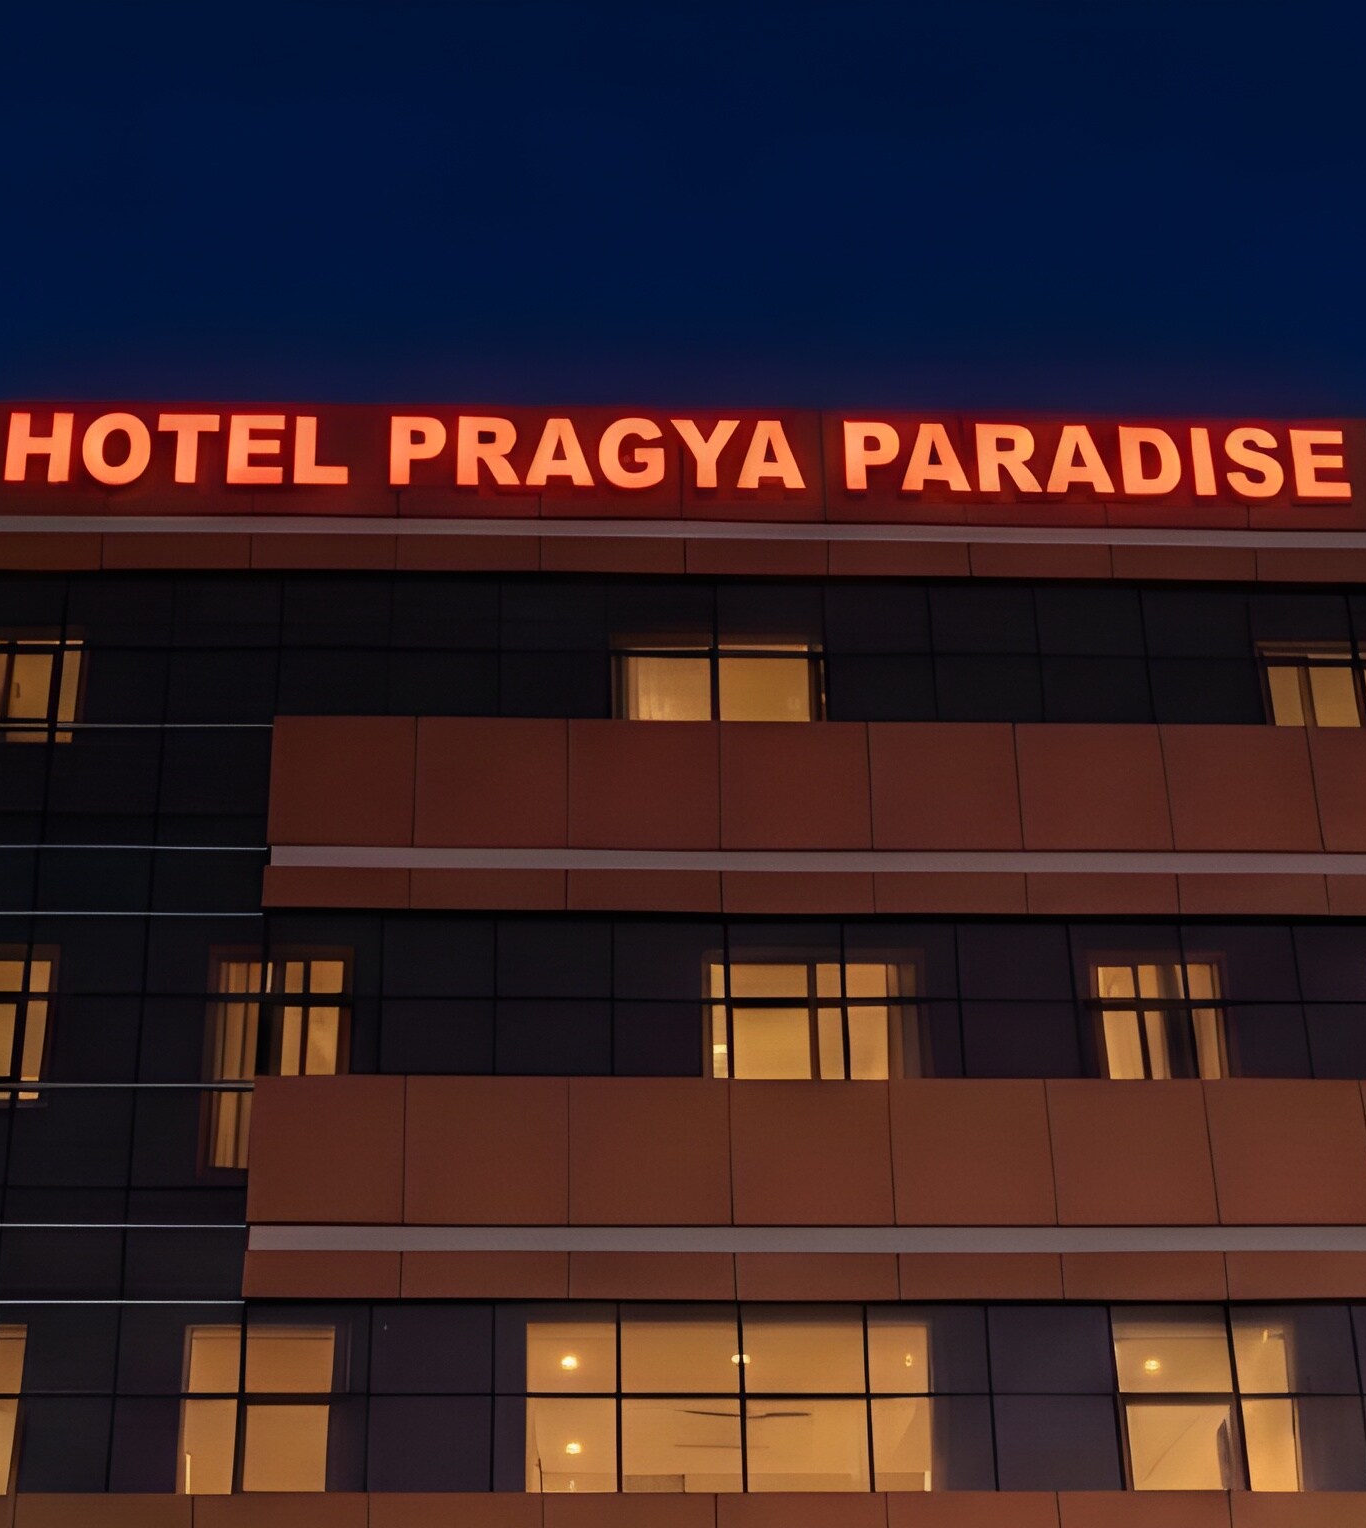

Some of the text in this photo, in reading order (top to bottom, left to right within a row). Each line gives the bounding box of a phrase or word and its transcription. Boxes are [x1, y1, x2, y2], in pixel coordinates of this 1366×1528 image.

[3, 411, 1352, 499] HOTEL PRAGYA PARADISE
